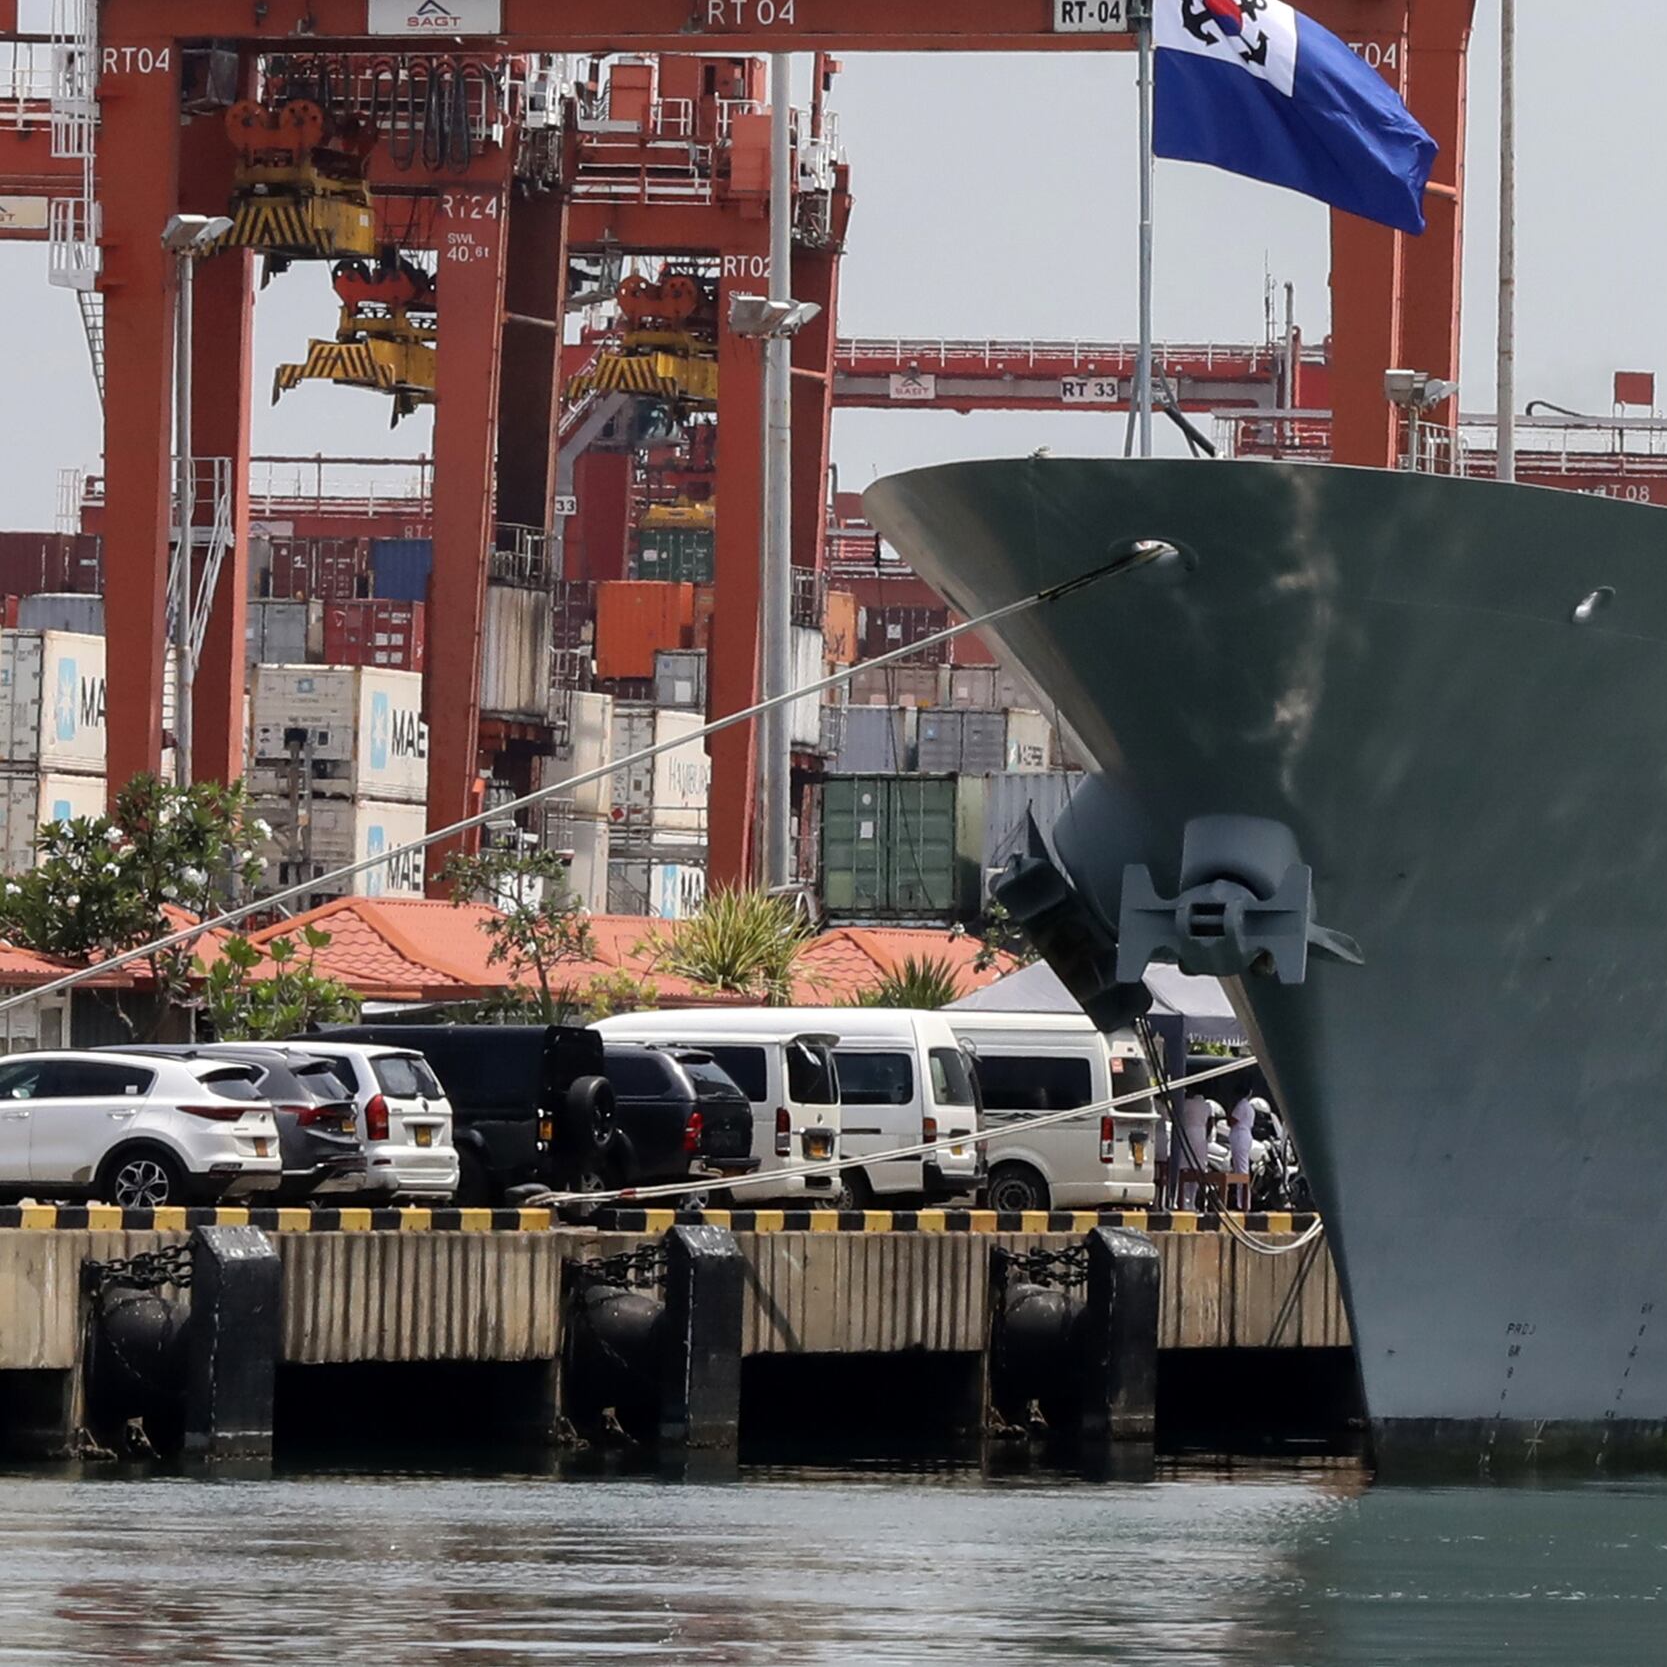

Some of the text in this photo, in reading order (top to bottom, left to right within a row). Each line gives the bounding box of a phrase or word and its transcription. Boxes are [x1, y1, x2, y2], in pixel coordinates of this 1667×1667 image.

[407, 16, 461, 27] SAGT
[102, 47, 171, 74] RT04
[447, 232, 475, 245] SWL
[1062, 381, 1116, 397] RT 33
[1625, 485, 1650, 502] 08
[556, 500, 575, 512] 33
